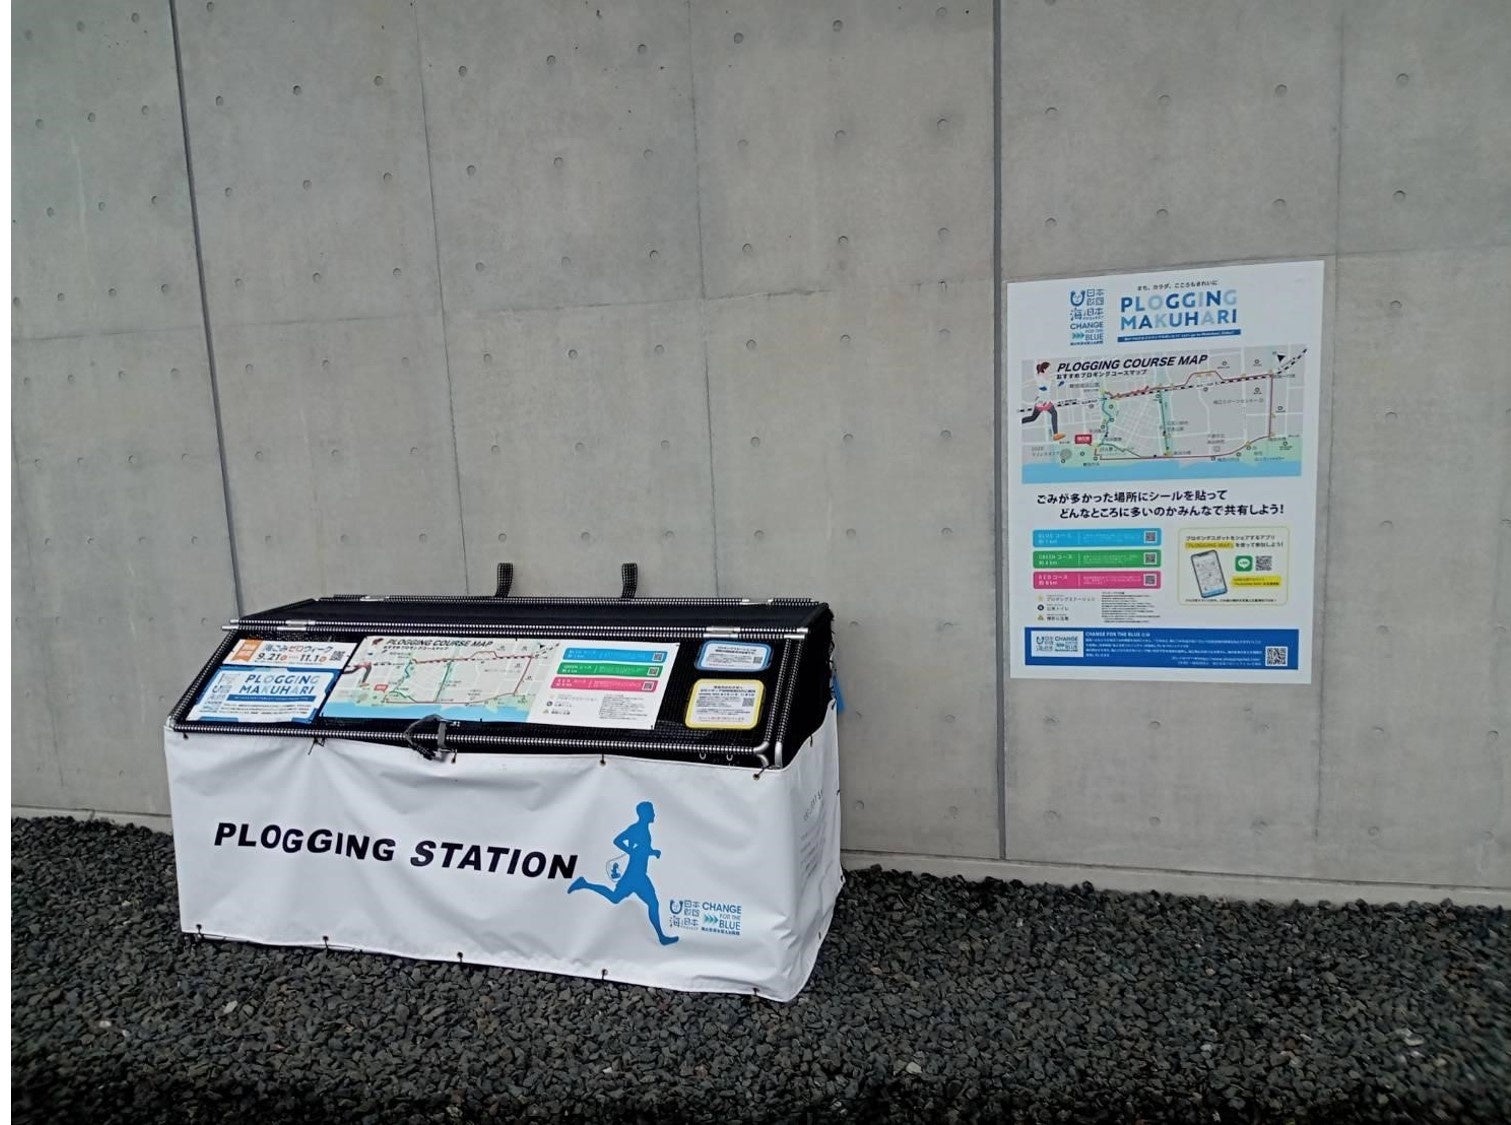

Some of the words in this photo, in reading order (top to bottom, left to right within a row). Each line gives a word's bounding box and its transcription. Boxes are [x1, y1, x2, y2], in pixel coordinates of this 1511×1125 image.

[1120, 289, 1237, 313] PLOGGING
[1069, 321, 1104, 330] CHANGE
[1120, 309, 1237, 331] MAKUHARI
[1056, 359, 1120, 373] PLOGGING
[1123, 356, 1176, 369] COURSE
[1177, 354, 1209, 366] MAP
[1036, 489, 1228, 505] ごみが多かった場所にシールを貼って
[244, 673, 321, 685] PLOGGING
[238, 685, 315, 695] MAKUHARI
[213, 822, 397, 862] PLOGGING
[410, 840, 578, 880] STATION
[701, 901, 742, 915] CHANGE
[718, 920, 741, 931] BLUE
